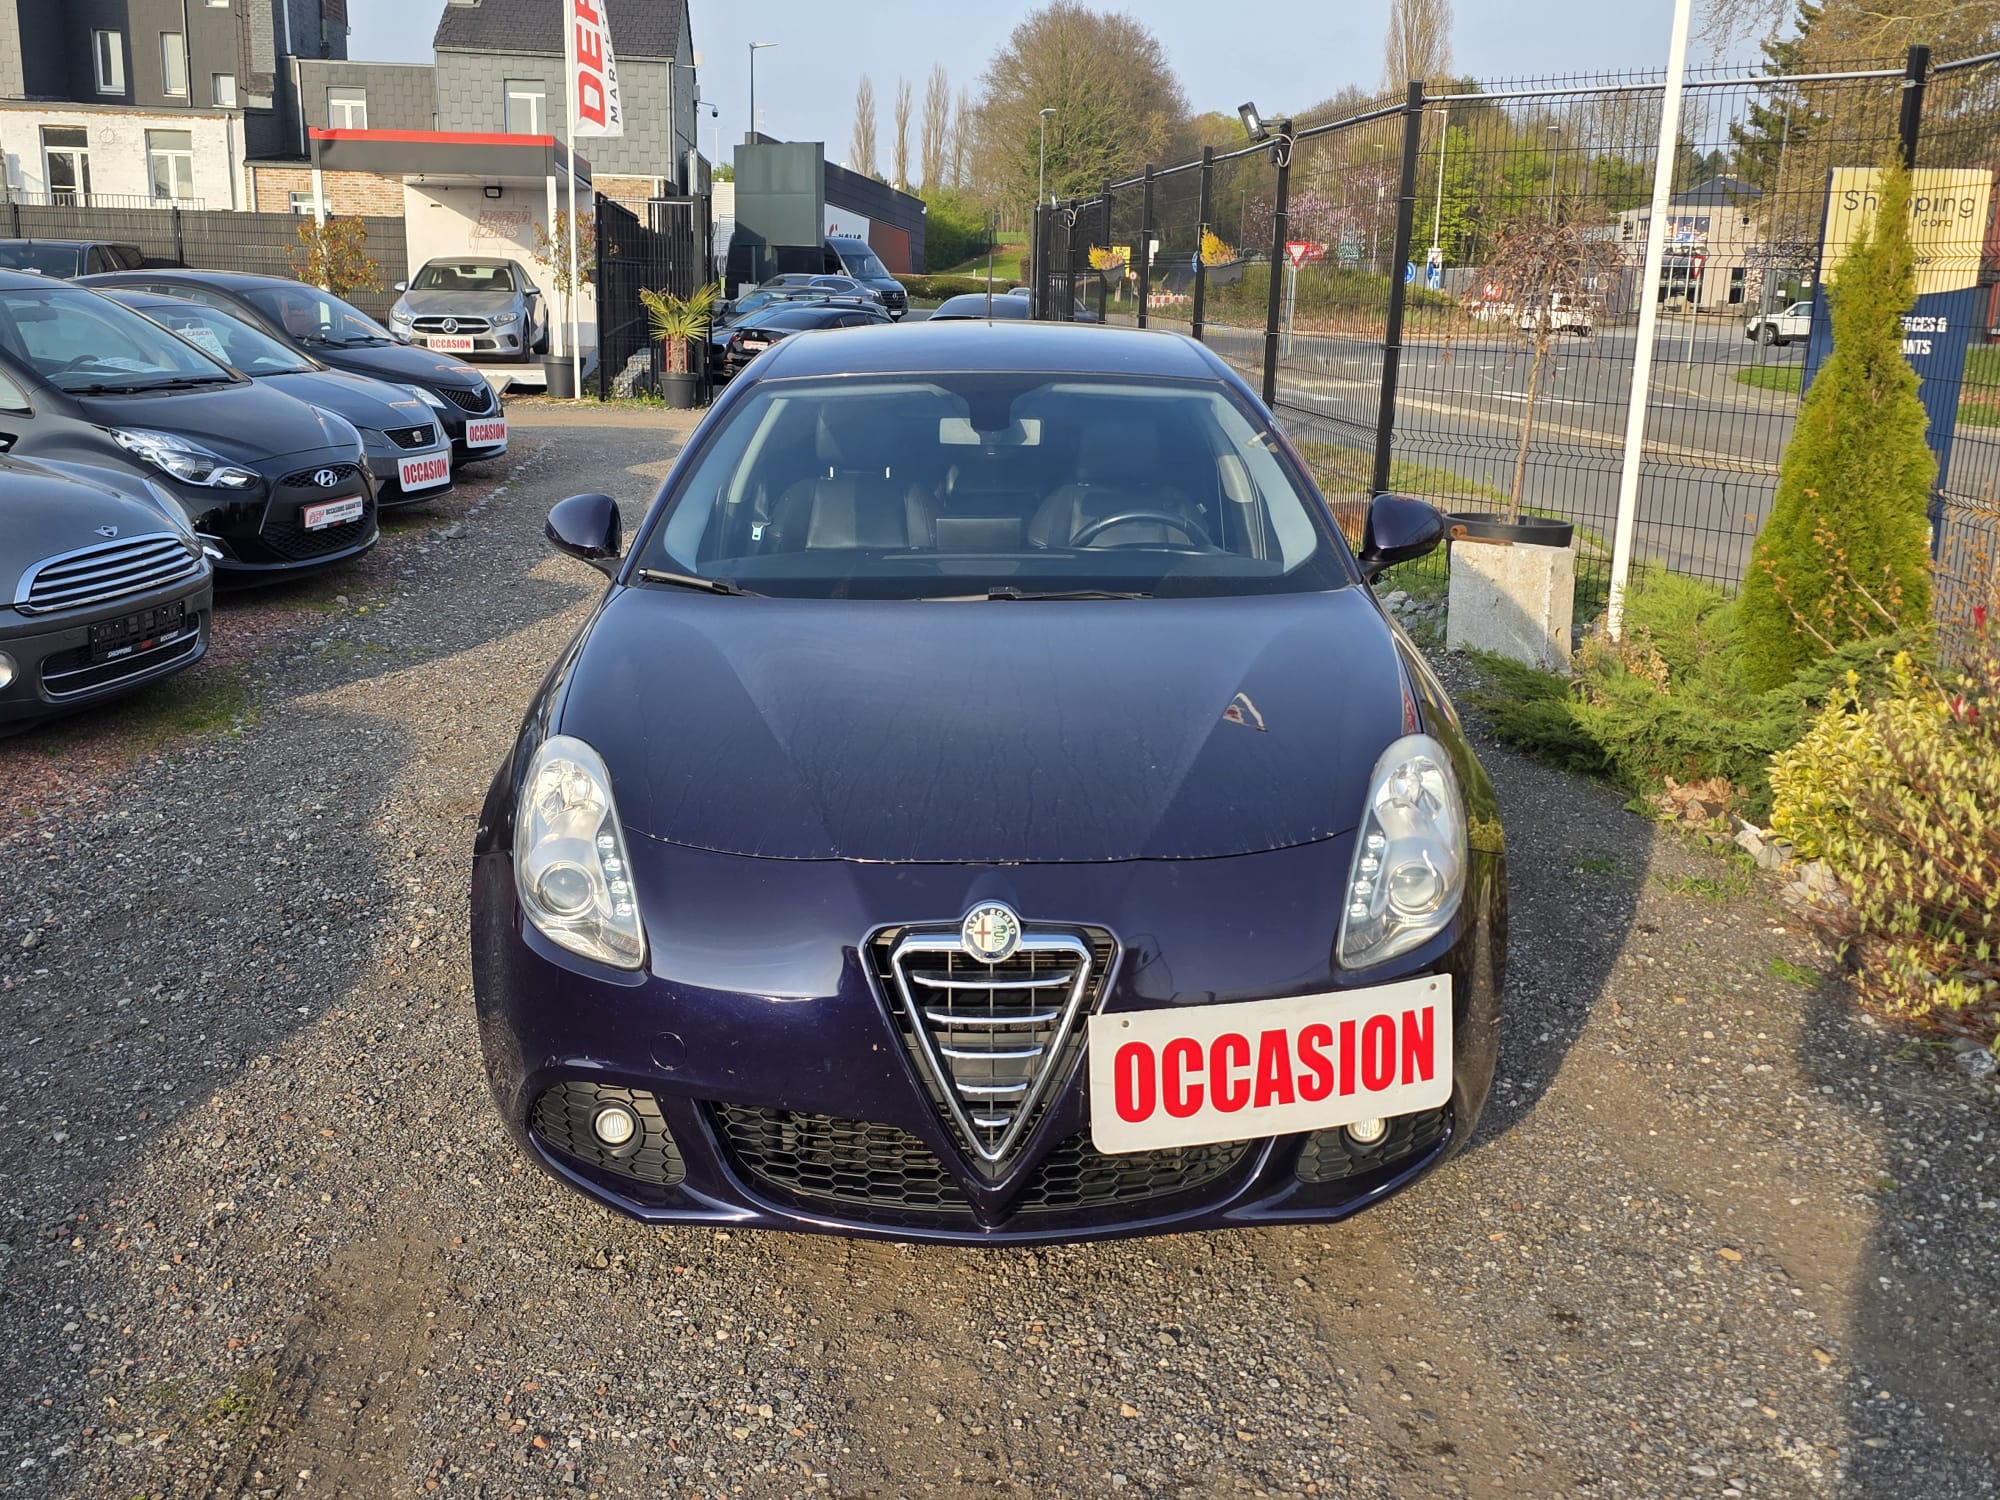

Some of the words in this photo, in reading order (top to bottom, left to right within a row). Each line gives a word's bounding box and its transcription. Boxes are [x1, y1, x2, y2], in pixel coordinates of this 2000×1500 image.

[430, 339, 471, 349] OCCASION
[469, 423, 505, 442] OCCASION
[403, 458, 448, 485] OCCASION
[966, 911, 985, 935] ALFA
[990, 909, 1016, 935] ROMEO
[1114, 1006, 1435, 1123] OCCASION
